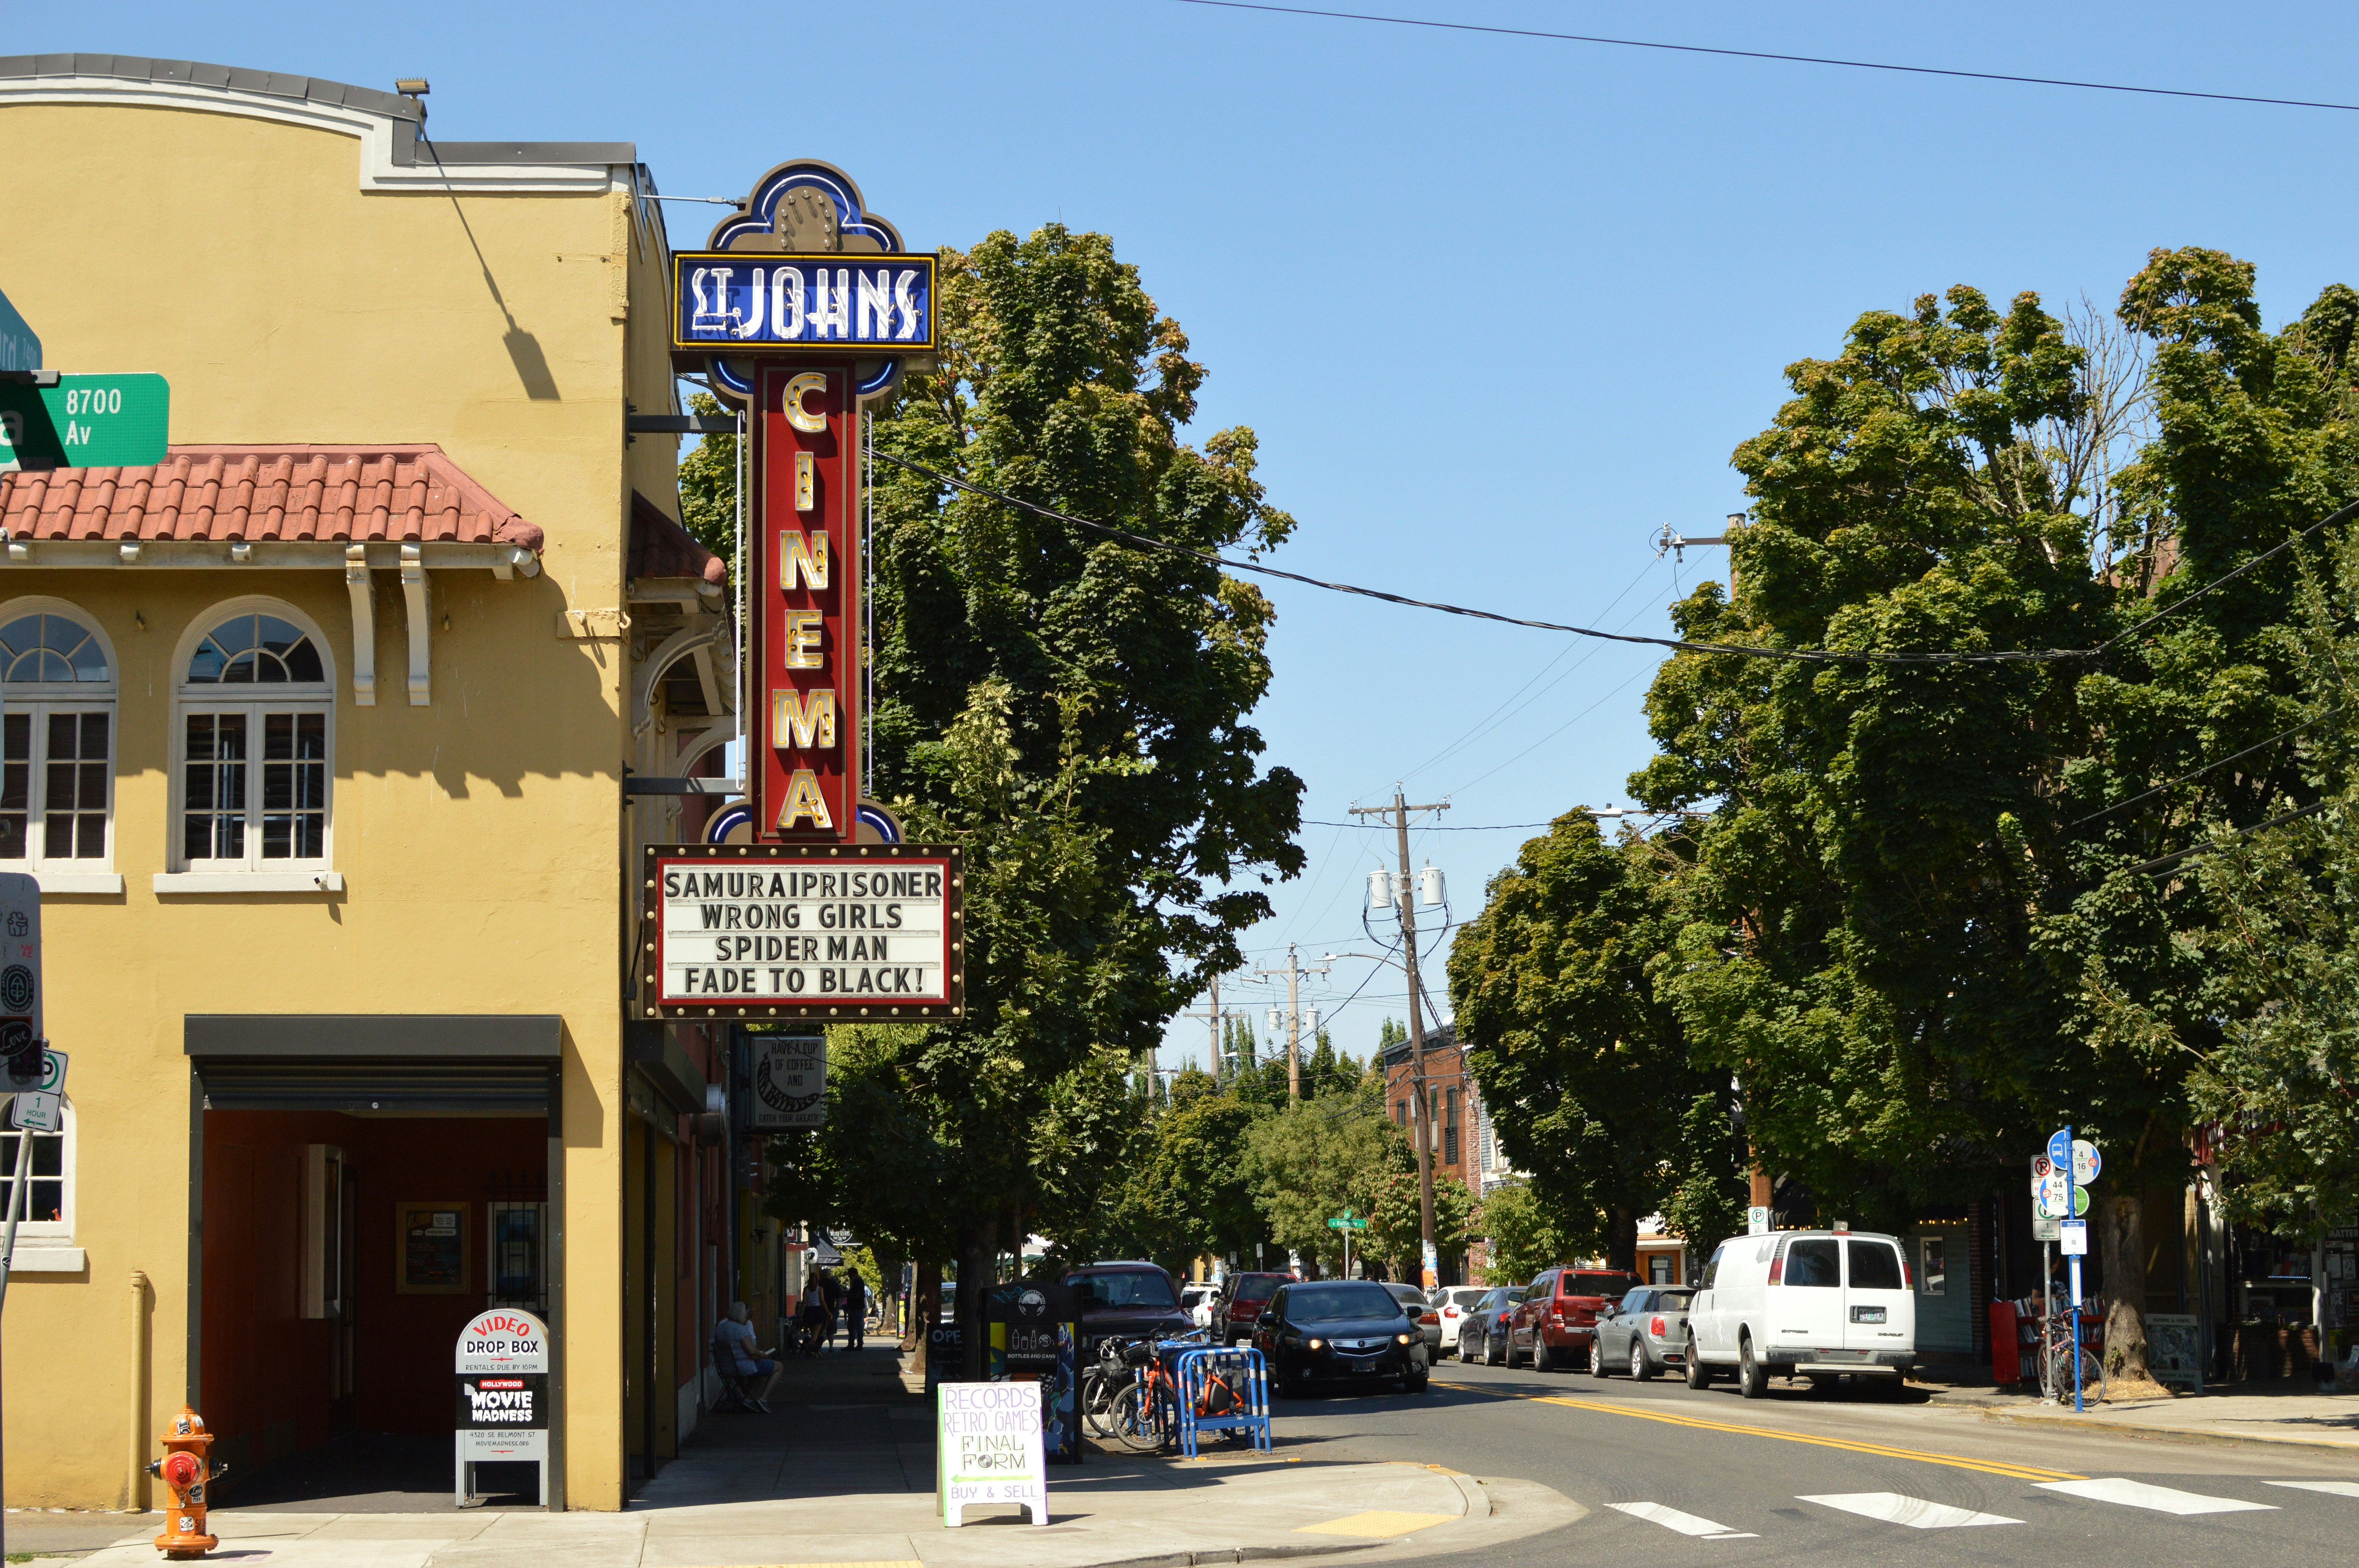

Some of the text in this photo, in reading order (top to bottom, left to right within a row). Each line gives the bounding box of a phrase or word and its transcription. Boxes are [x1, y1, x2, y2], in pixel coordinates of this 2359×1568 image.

[739, 266, 920, 339] JOHNS
[66, 388, 122, 414] 8700
[65, 421, 91, 445] Av
[772, 372, 835, 828] CINEMA
[701, 903, 902, 929] WRONG GIRLS
[2, 965, 28, 988] APPALACHIAN
[685, 967, 923, 993] FADE TO BLACK!
[2, 996, 33, 1011] CONSERVANCY
[0, 1031, 27, 1051] Love
[771, 1043, 818, 1054] HAVE A CUP
[775, 1059, 814, 1070] OF COFFEE
[787, 1075, 803, 1086] AND
[36, 1096, 41, 1109] 1
[27, 1109, 46, 1119] HOUR
[759, 1114, 776, 1122] CATCH
[796, 1114, 818, 1122] BREATH
[473, 1316, 530, 1337] VIDEO
[932, 1329, 963, 1344] OPE
[466, 1340, 539, 1354] DROP BOX
[472, 1391, 533, 1409] MOVIE
[945, 1387, 1036, 1410] RECORDS
[472, 1410, 533, 1422] MADNESS
[943, 1410, 1039, 1437] RETRO GAMES
[961, 1435, 1024, 1452] FINAL
[951, 1485, 1038, 1499] BUY & SELL
